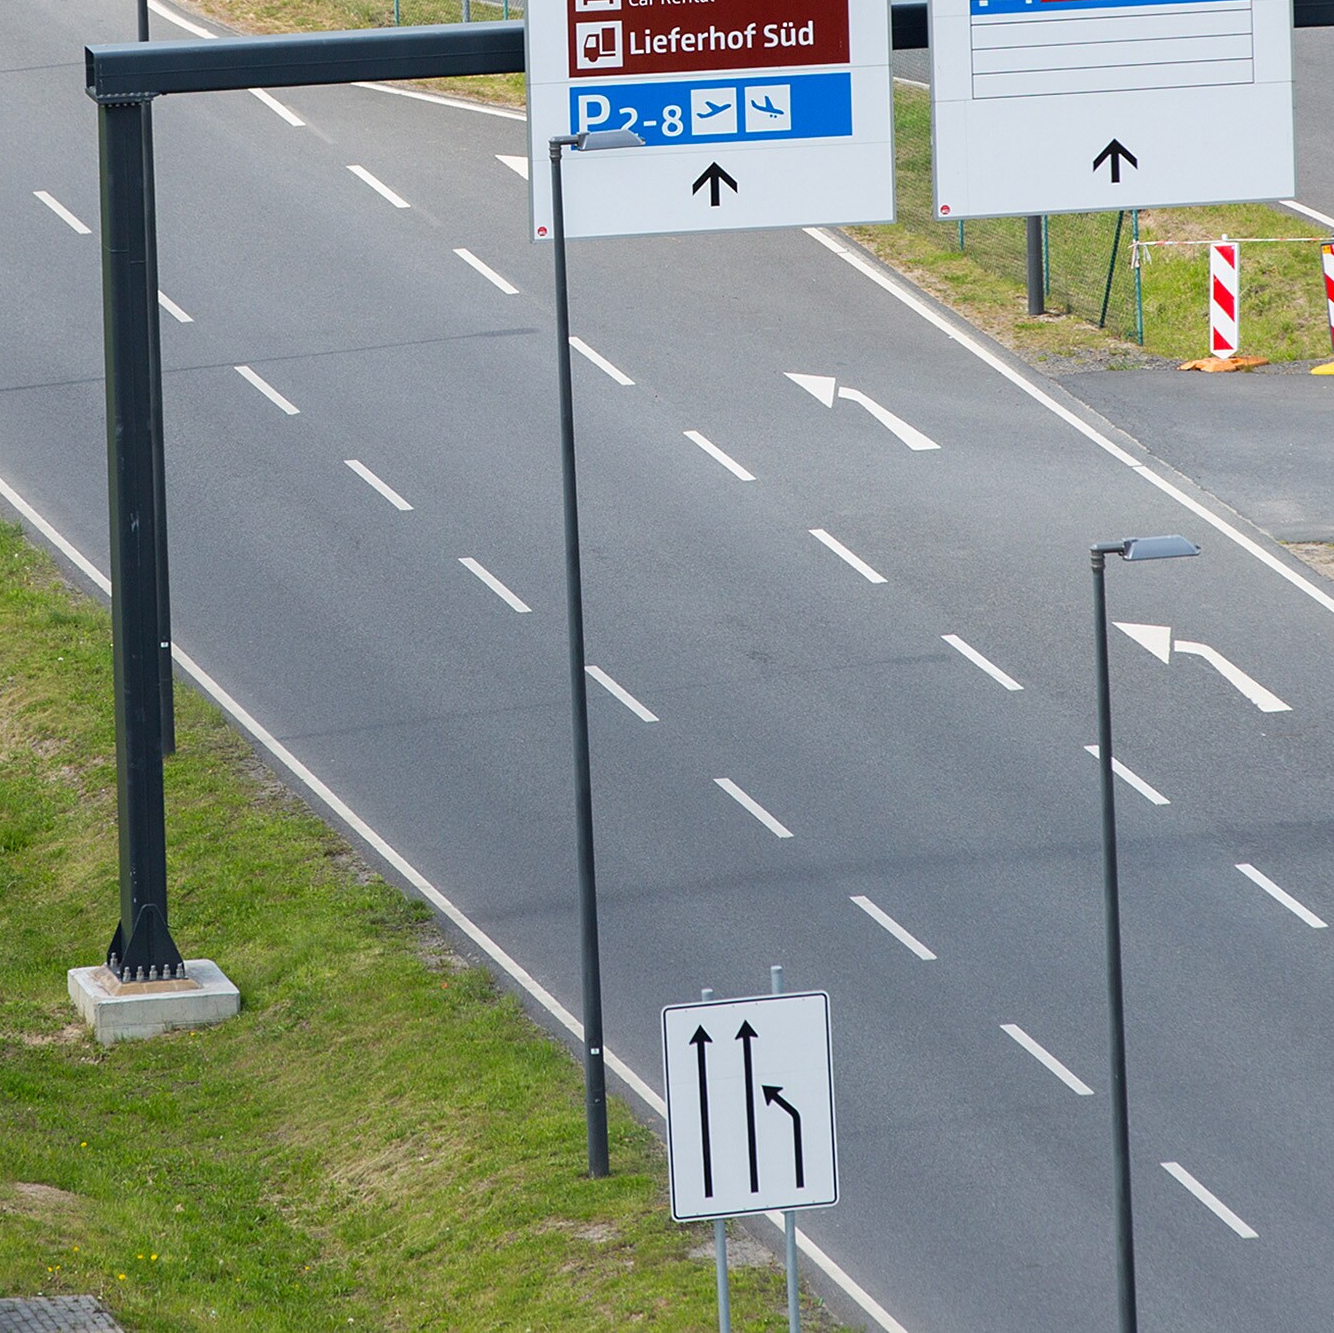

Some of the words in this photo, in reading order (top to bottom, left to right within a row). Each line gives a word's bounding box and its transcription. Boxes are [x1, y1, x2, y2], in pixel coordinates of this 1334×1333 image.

[628, 23, 757, 55] Lieferhof
[762, 20, 814, 48] Süd
[618, 104, 684, 137] 2-8
